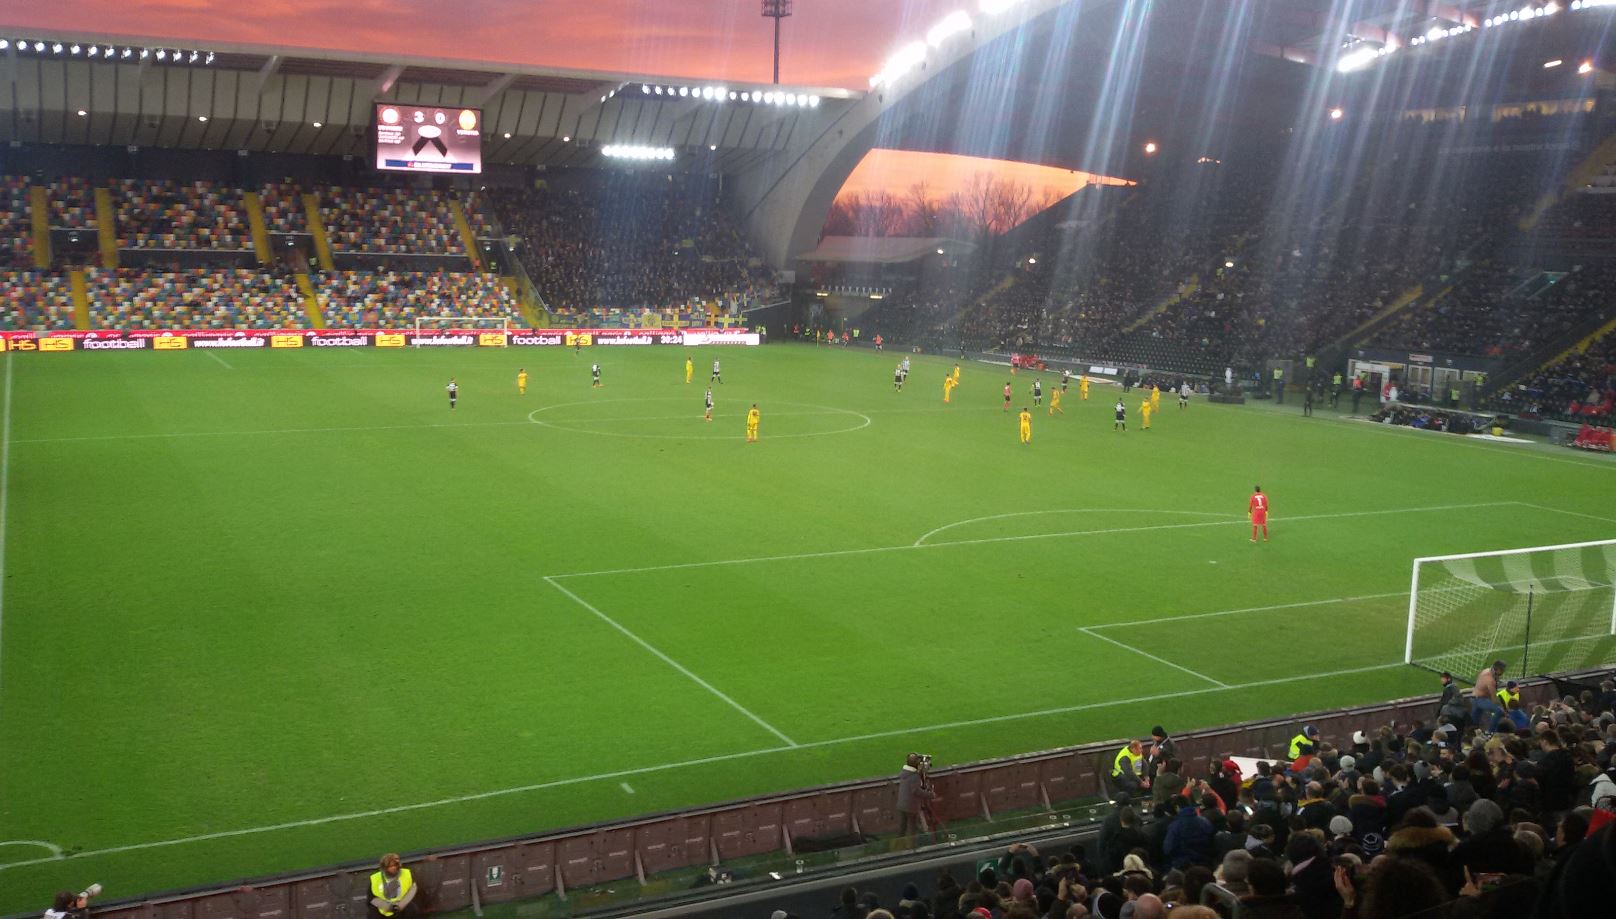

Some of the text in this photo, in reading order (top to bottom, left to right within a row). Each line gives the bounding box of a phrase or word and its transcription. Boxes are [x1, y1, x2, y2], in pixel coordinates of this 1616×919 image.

[83, 338, 146, 349] football
[311, 336, 368, 346] football
[512, 335, 562, 345] football
